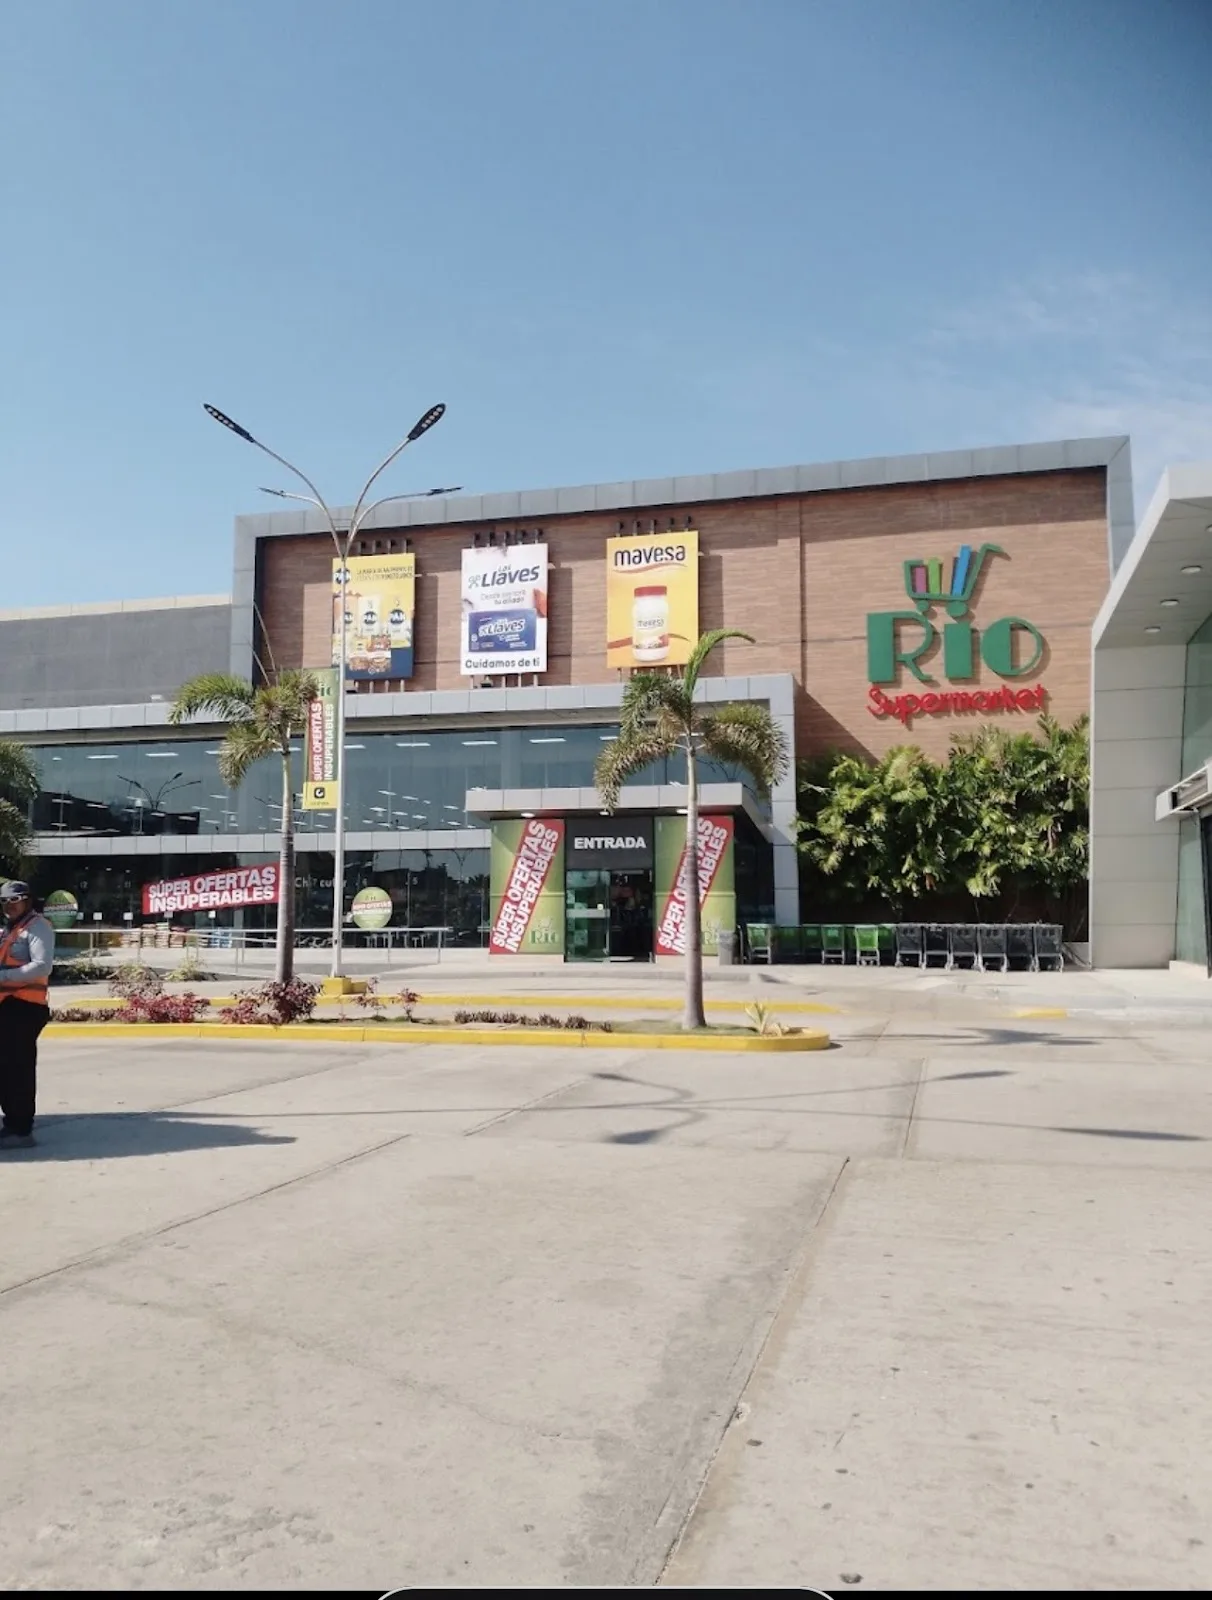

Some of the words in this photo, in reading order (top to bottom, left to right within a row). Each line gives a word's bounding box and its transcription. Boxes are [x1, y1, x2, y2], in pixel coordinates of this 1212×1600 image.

[614, 545, 686, 566] mavesa
[481, 565, 540, 588] Llaves
[465, 658, 516, 669] Cuidamos
[518, 657, 531, 667] de
[532, 657, 540, 667] ti
[867, 684, 1048, 724] Supermarket
[310, 702, 323, 754] OFERTAS
[324, 703, 334, 781] INSUPERABLES
[574, 836, 647, 850] ENTRADA
[148, 880, 191, 899] SÚPER
[193, 866, 276, 893] OFERTAS
[149, 885, 275, 913] INSUPERABLES
[492, 902, 518, 948] SÚPER
[507, 820, 547, 902] OFERTAS
[505, 828, 559, 953] INSUPERABLES
[658, 900, 686, 949] SÚPER
